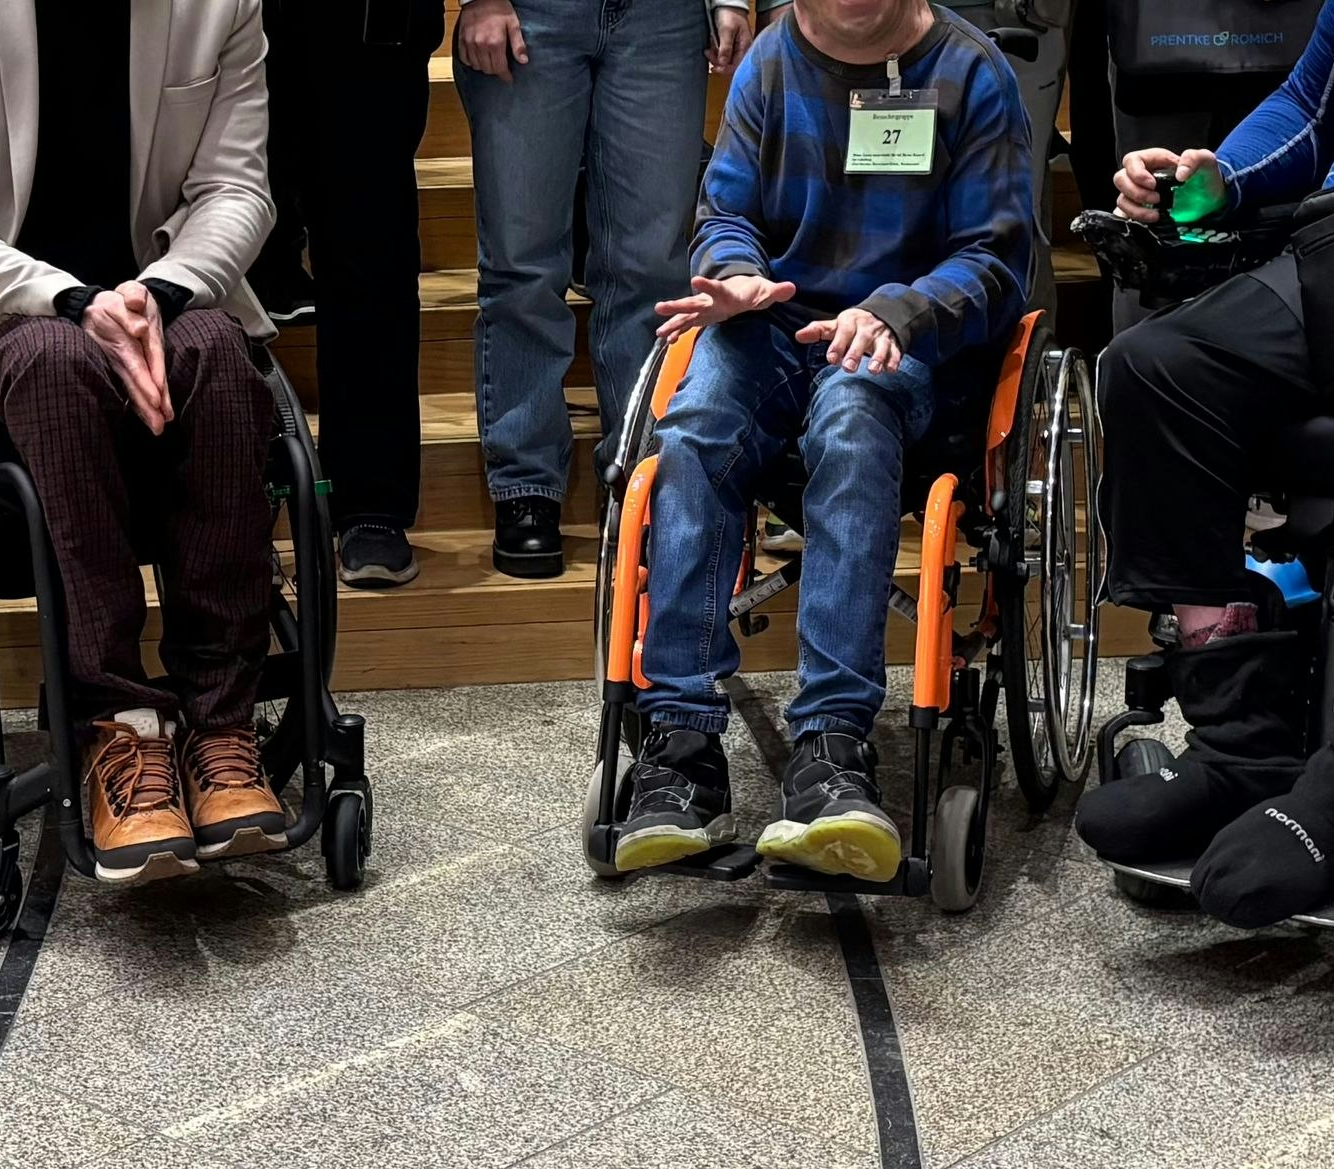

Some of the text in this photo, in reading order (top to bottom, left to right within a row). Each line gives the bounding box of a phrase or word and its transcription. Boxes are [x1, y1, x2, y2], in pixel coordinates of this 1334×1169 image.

[1150, 32, 1284, 46] PRENTKE ROMICH
[882, 129, 902, 145] 27
[1264, 807, 1326, 863] normani
